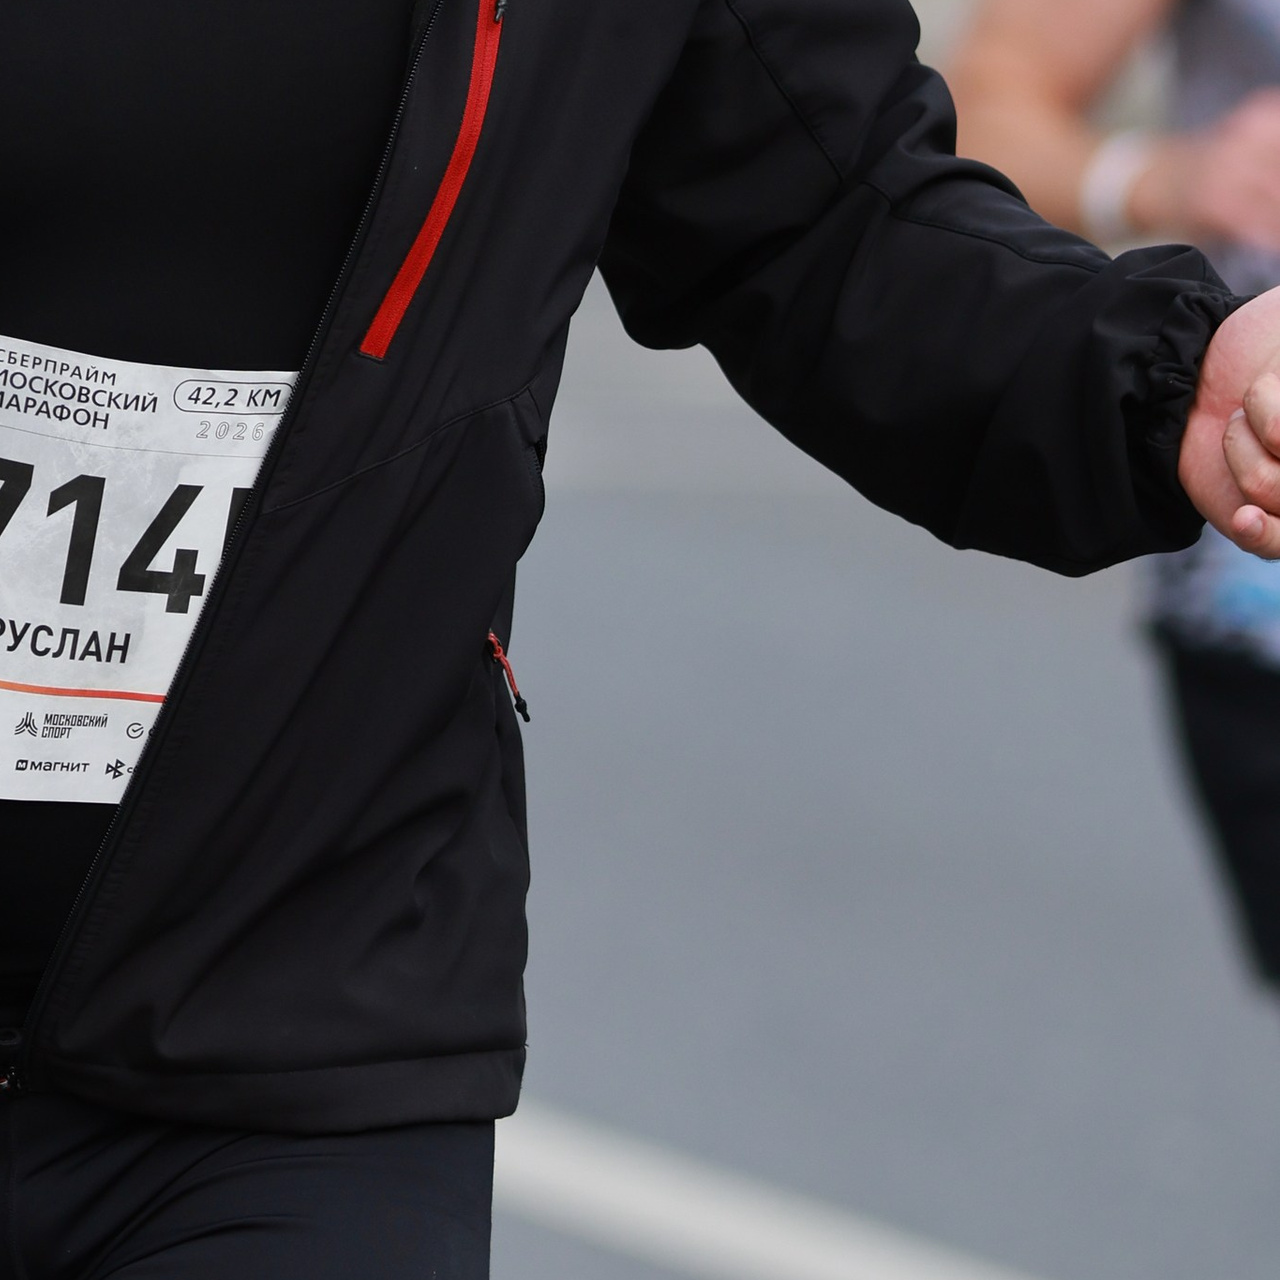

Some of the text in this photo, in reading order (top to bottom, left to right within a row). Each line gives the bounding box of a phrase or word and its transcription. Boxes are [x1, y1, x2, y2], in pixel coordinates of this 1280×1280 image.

[187, 386, 239, 408] 42,2
[196, 420, 265, 441] 2026
[43, 713, 108, 728] МОСКОВСКИЙ
[41, 726, 73, 739] СПОРТ
